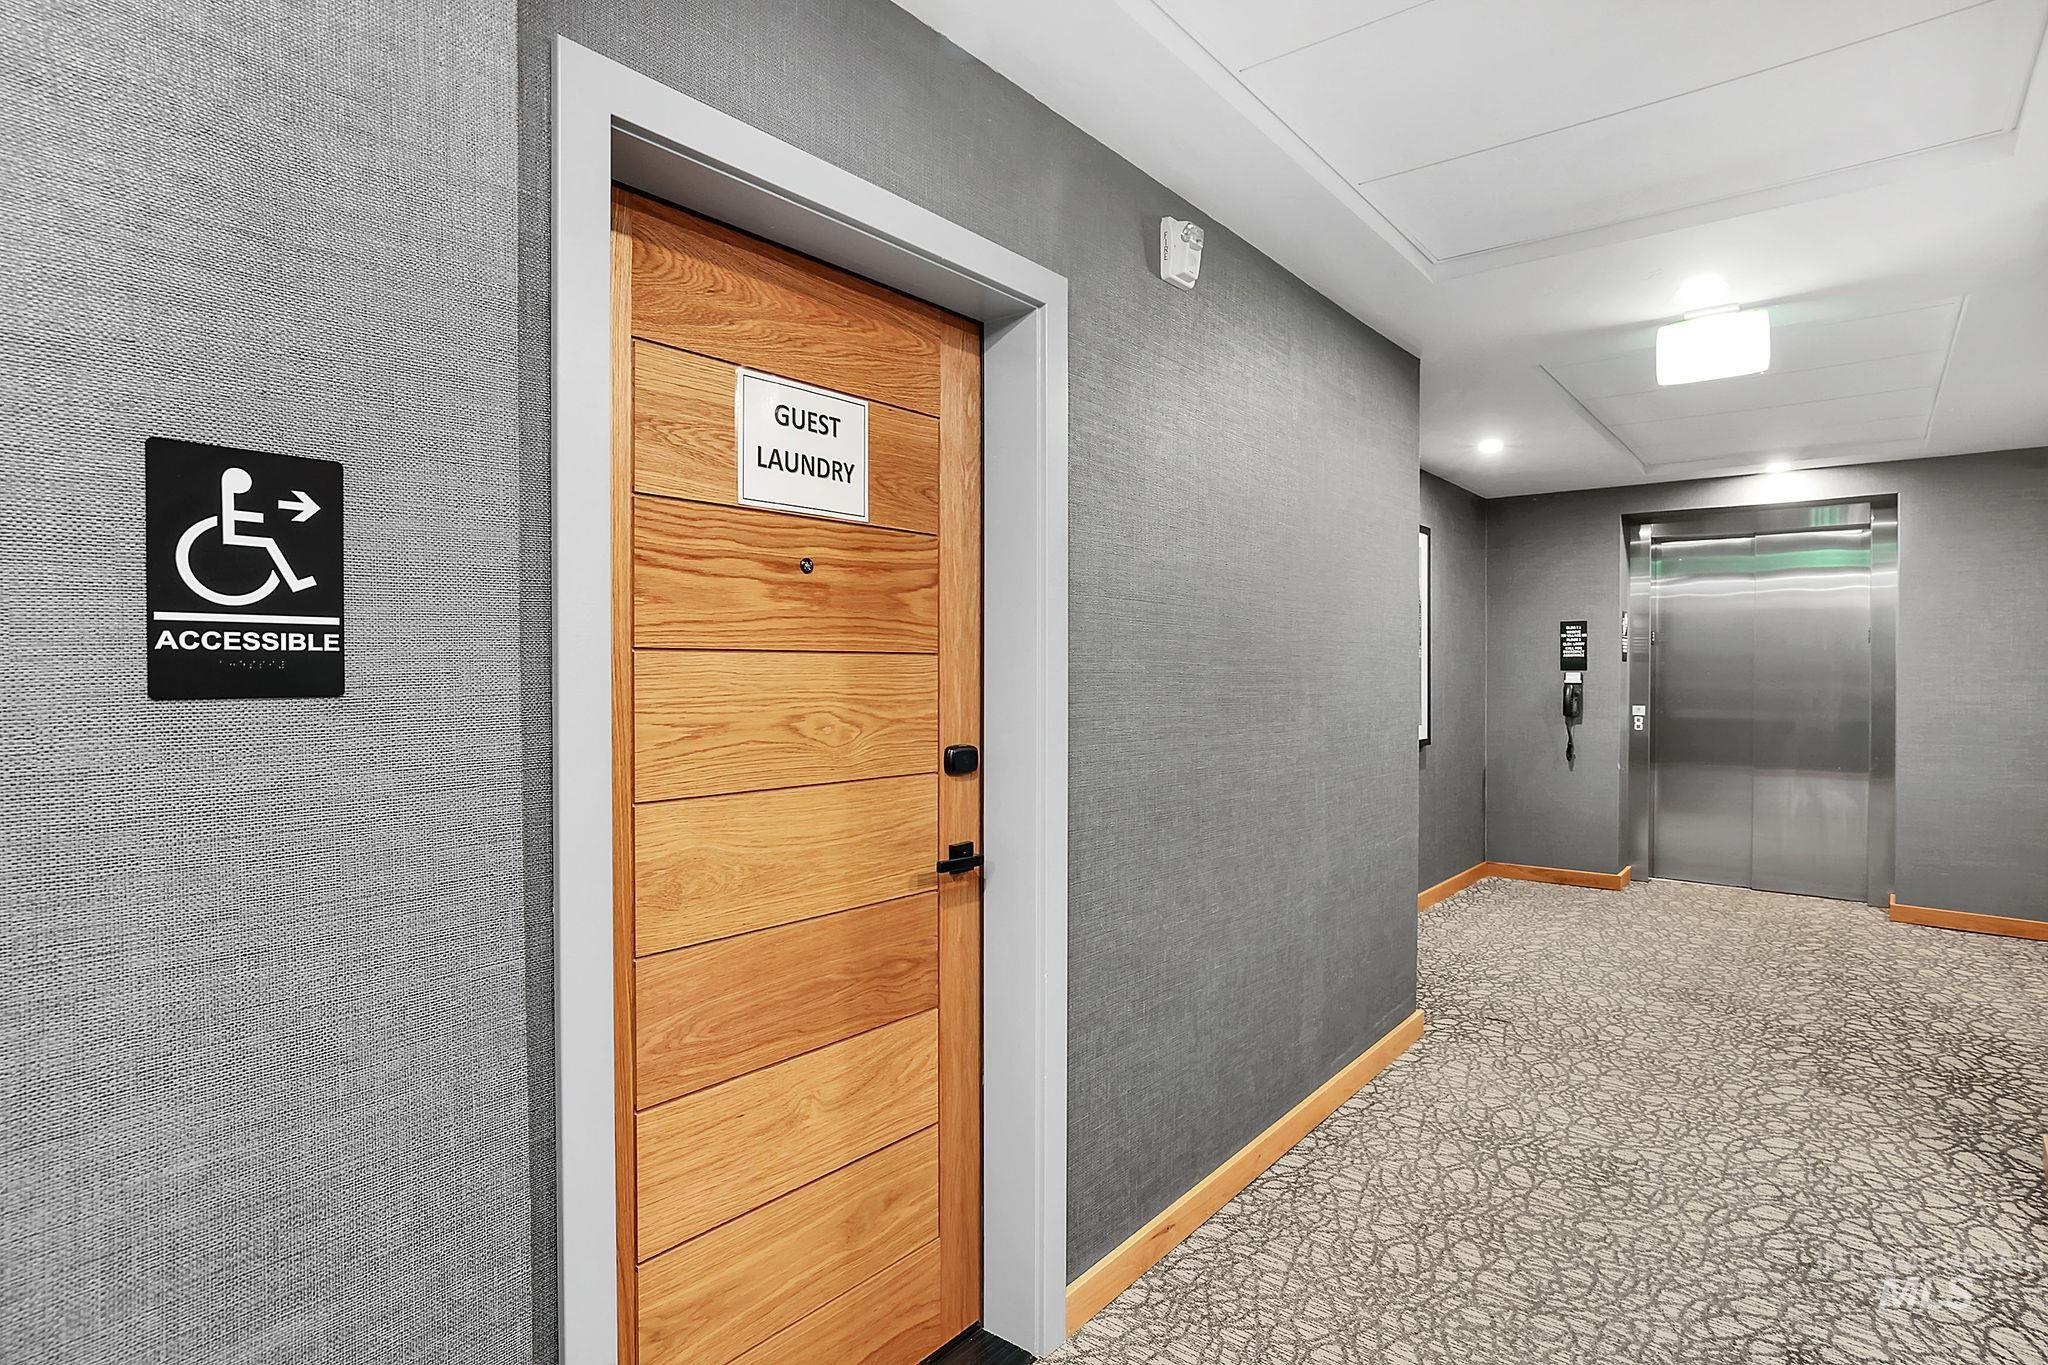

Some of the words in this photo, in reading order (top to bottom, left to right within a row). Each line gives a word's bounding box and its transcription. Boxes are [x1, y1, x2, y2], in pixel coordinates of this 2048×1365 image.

[774, 404, 841, 438] GUEST
[756, 445, 856, 484] LAUNDRY
[154, 629, 341, 652] ACCESSIBLE
